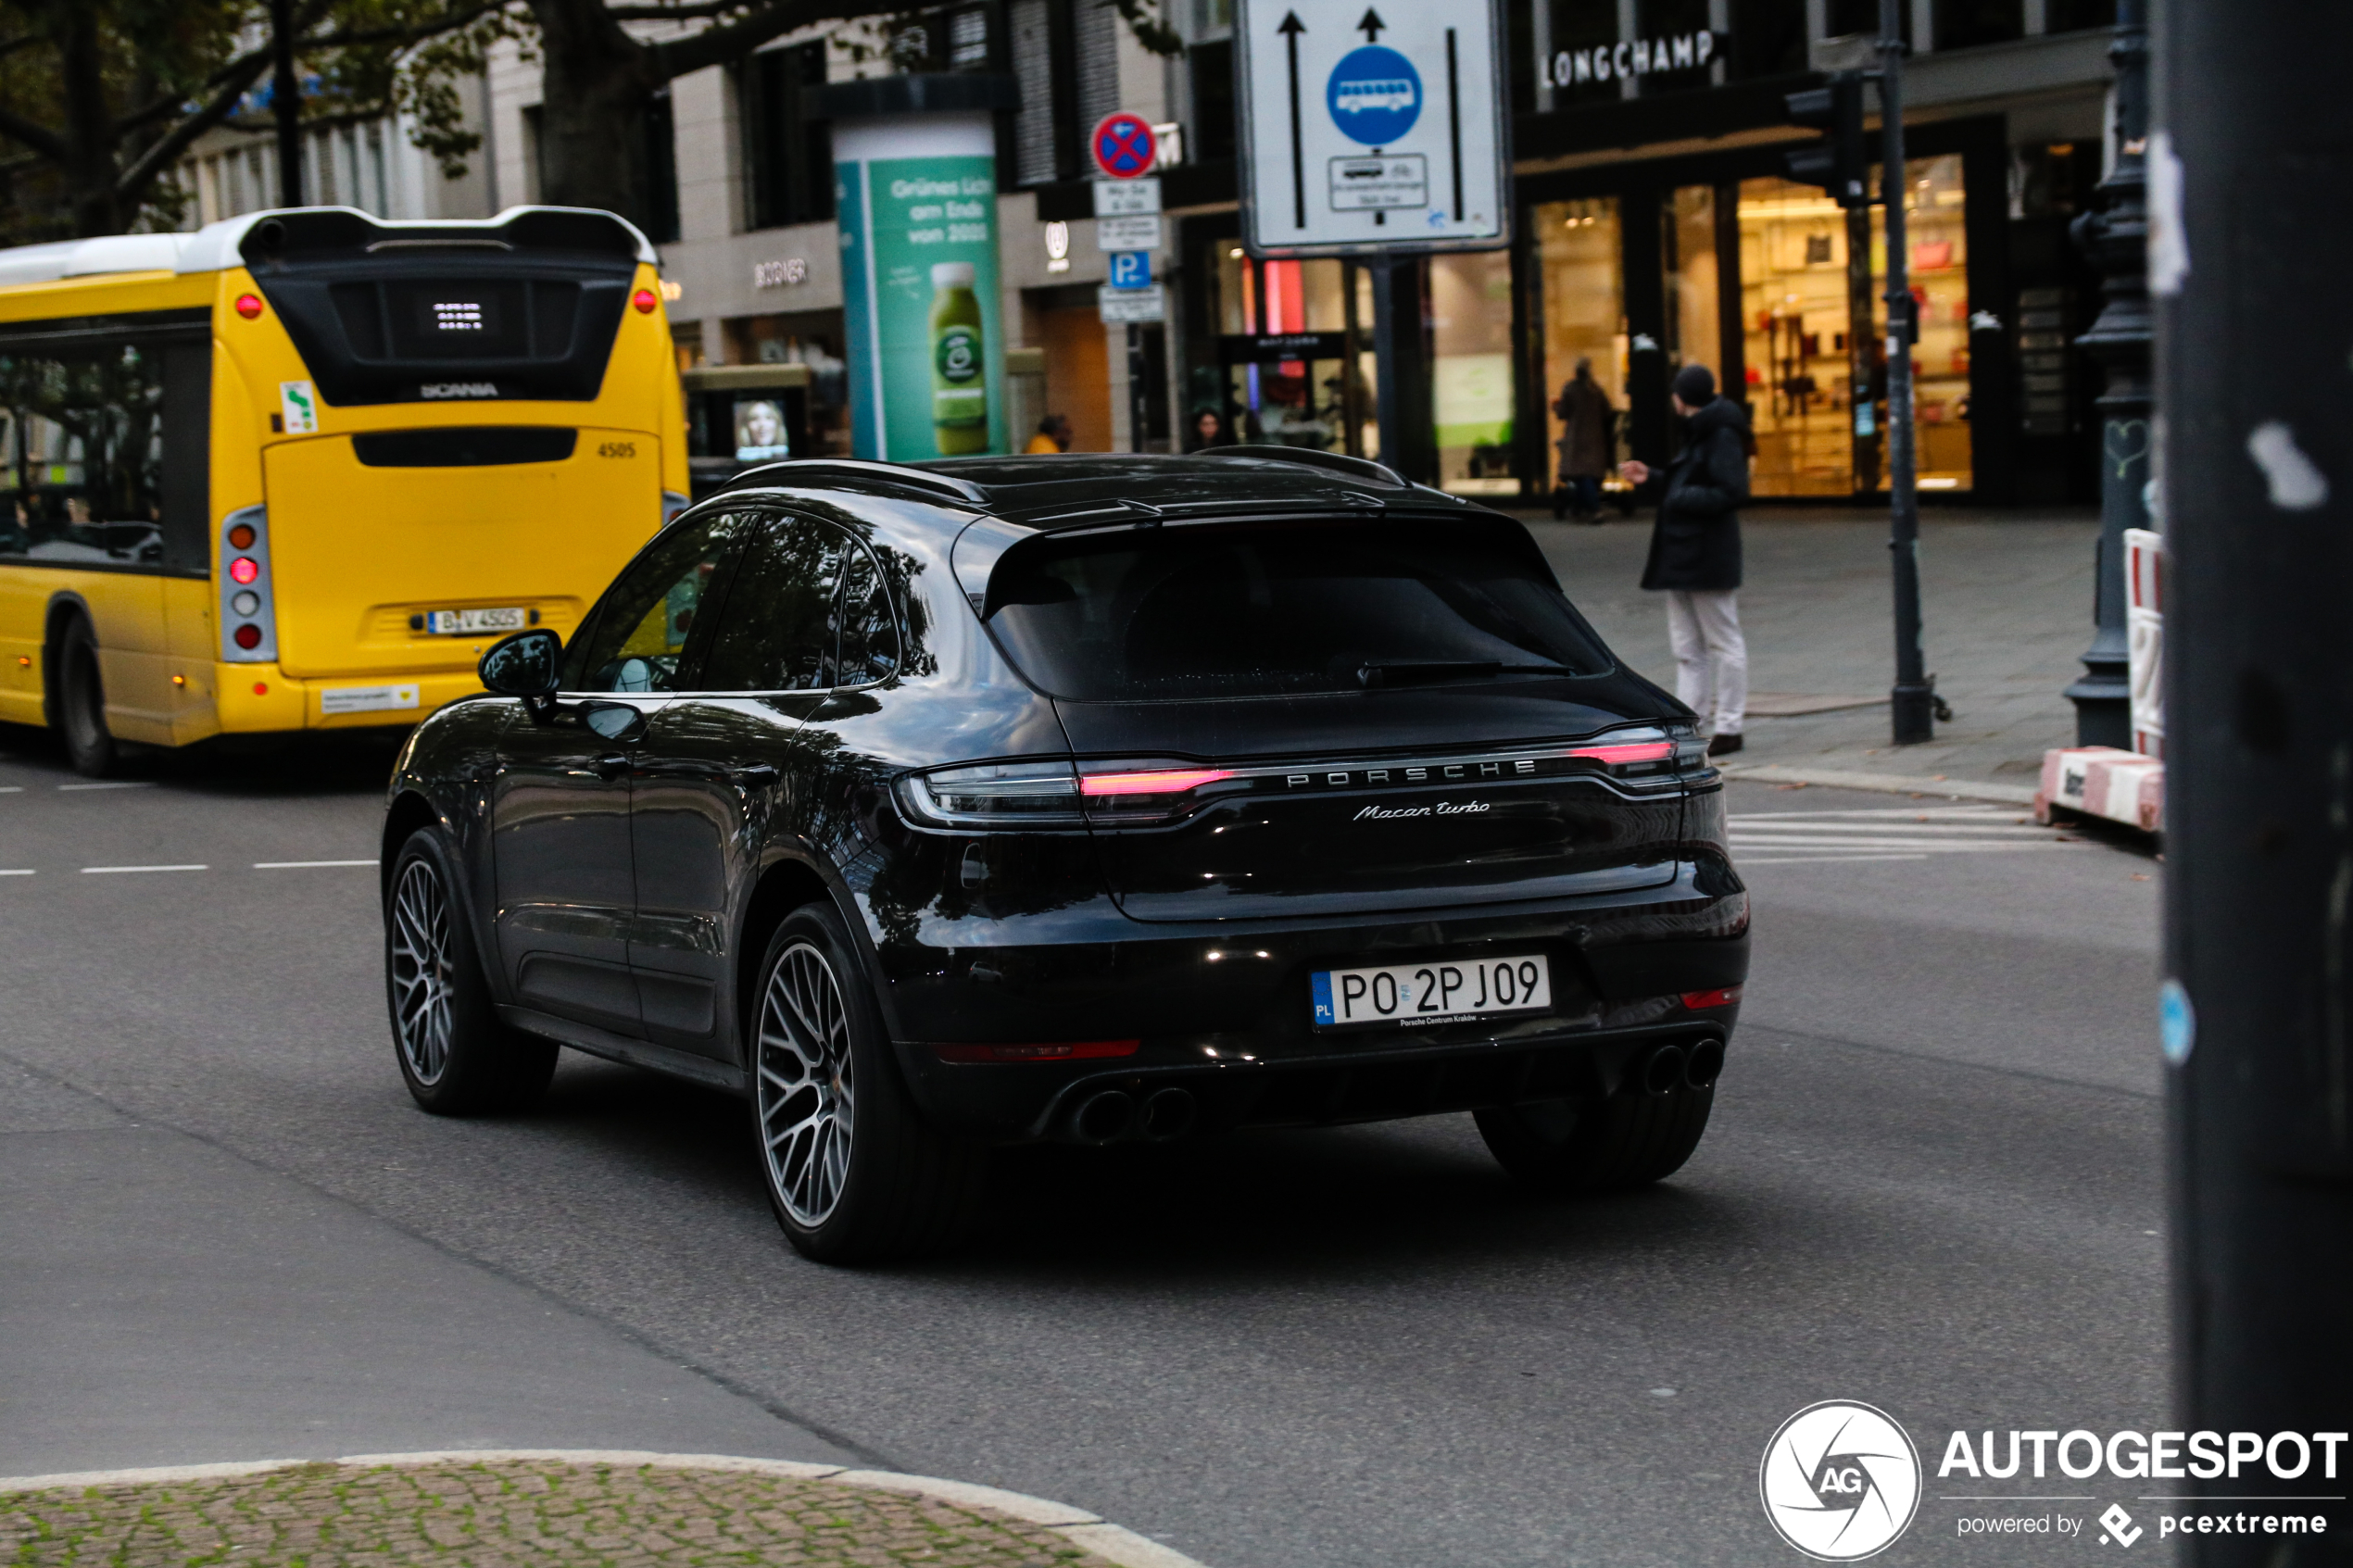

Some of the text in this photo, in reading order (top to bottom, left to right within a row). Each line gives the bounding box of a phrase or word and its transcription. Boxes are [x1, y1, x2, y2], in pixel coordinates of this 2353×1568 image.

[1540, 30, 1714, 89] LONGCHAMP
[891, 177, 959, 198] Grünes
[908, 228, 944, 244] von
[1116, 255, 1138, 283] P
[421, 383, 498, 398] SCANIA
[598, 443, 637, 458] 4505
[479, 609, 518, 627] 4505
[1287, 760, 1535, 787] PORSCHE
[1353, 806, 1431, 821] Macan
[1341, 972, 1398, 1018] PO
[1315, 1005, 1331, 1017] PL
[1400, 1014, 1477, 1026] Porsche Centrum Kraków
